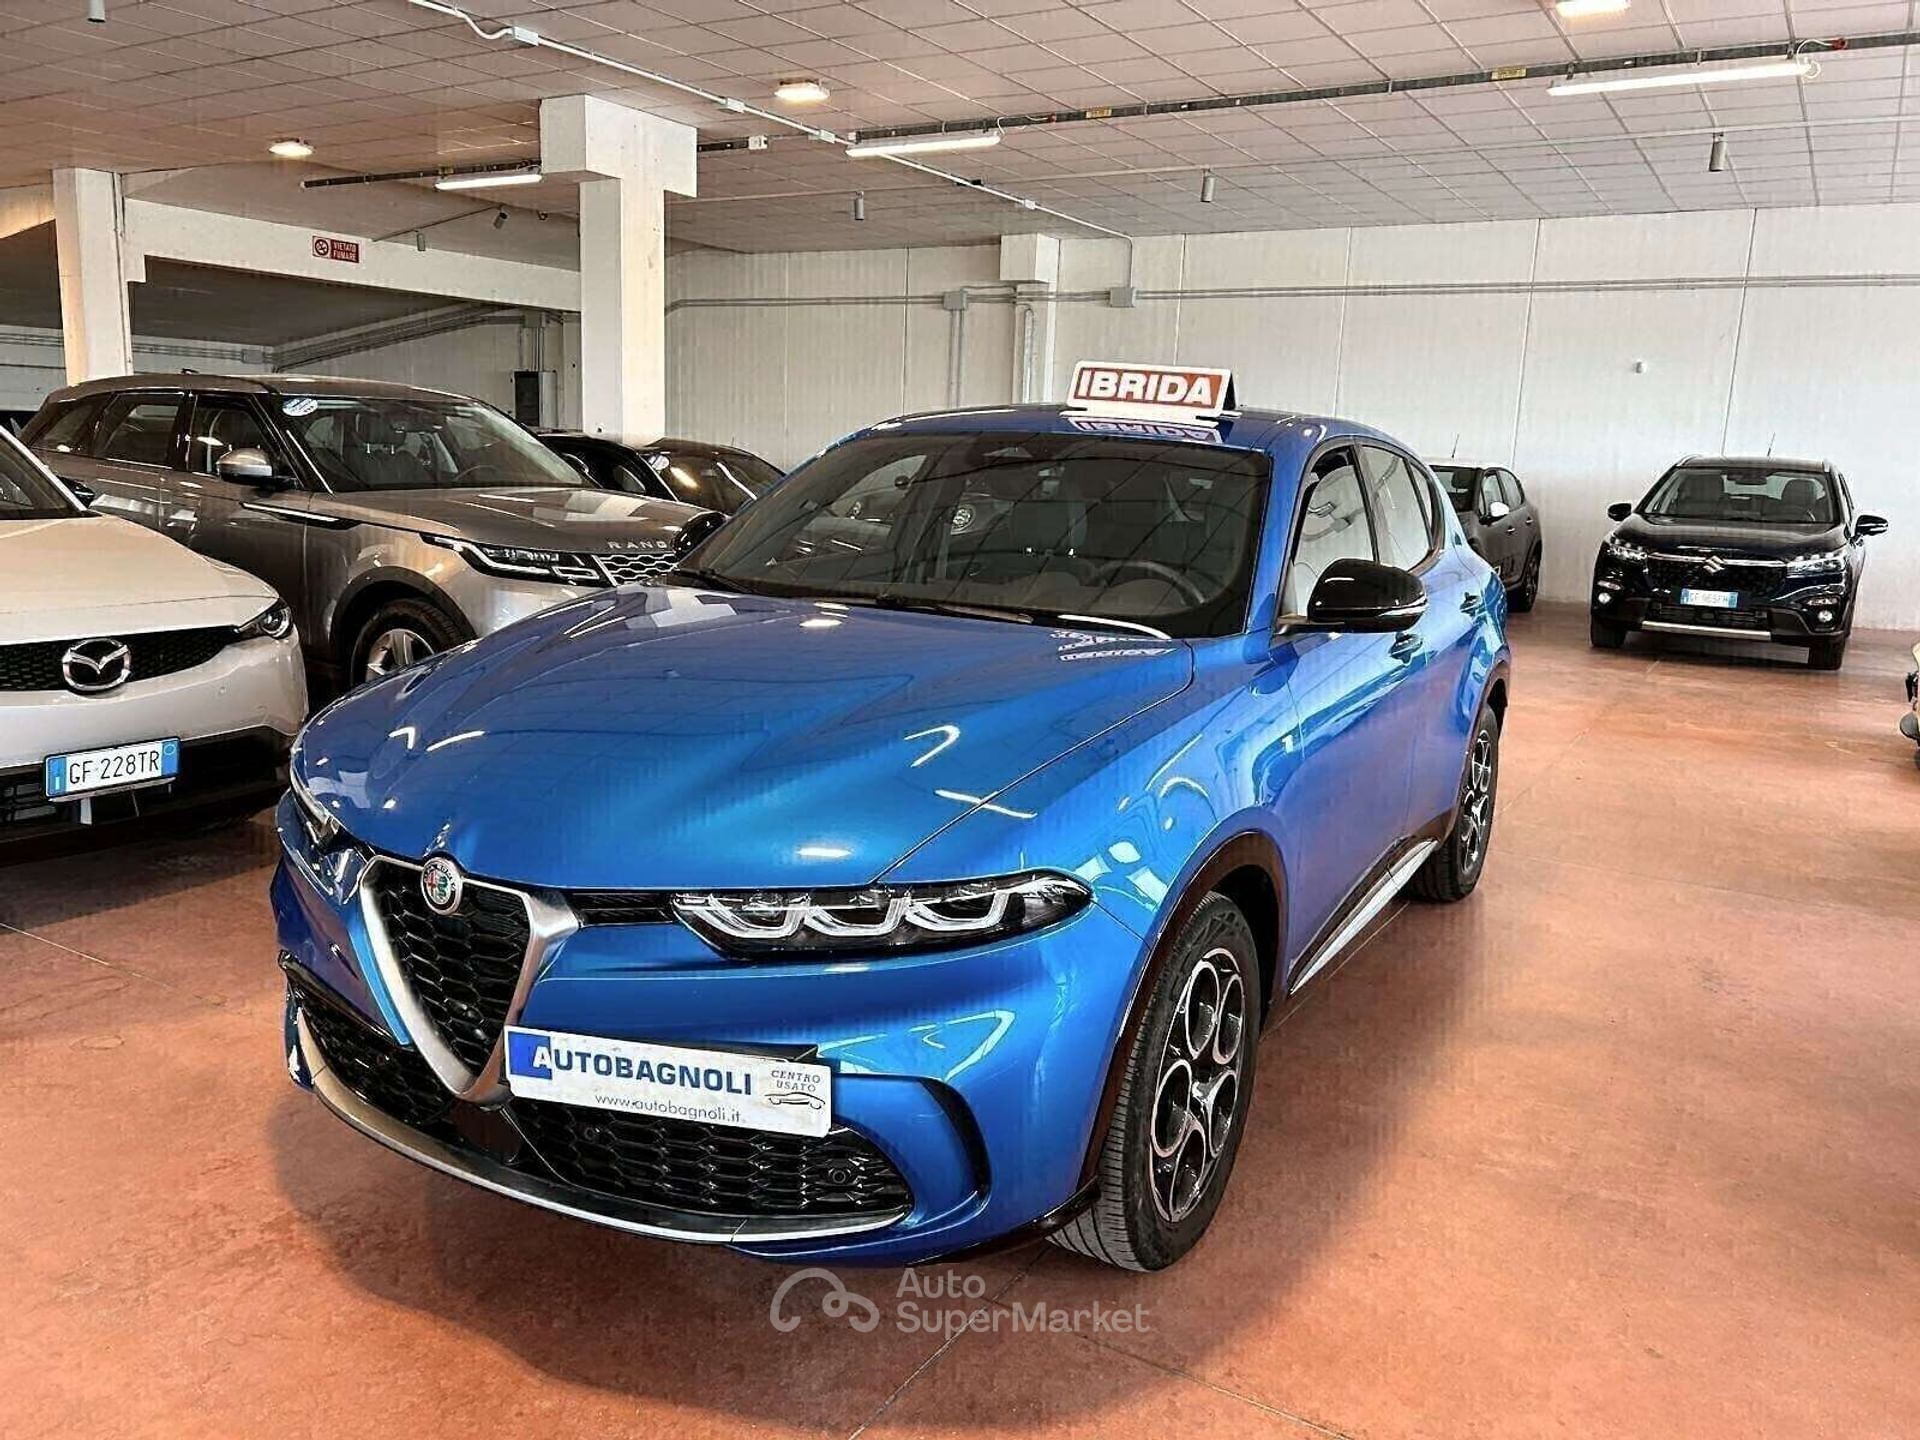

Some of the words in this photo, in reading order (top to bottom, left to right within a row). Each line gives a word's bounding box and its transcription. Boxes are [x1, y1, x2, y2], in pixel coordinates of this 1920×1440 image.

[332, 241, 357, 253] VIETATO
[1078, 369, 1213, 406] IBRIDA
[69, 760, 93, 784] GF
[100, 750, 160, 779] 228TR
[532, 1045, 751, 1096] AUTOBAGNOLI
[771, 1070, 821, 1084] CENTRO
[776, 1080, 817, 1093] USATO
[595, 1094, 741, 1122] www.autobagnoli.it
